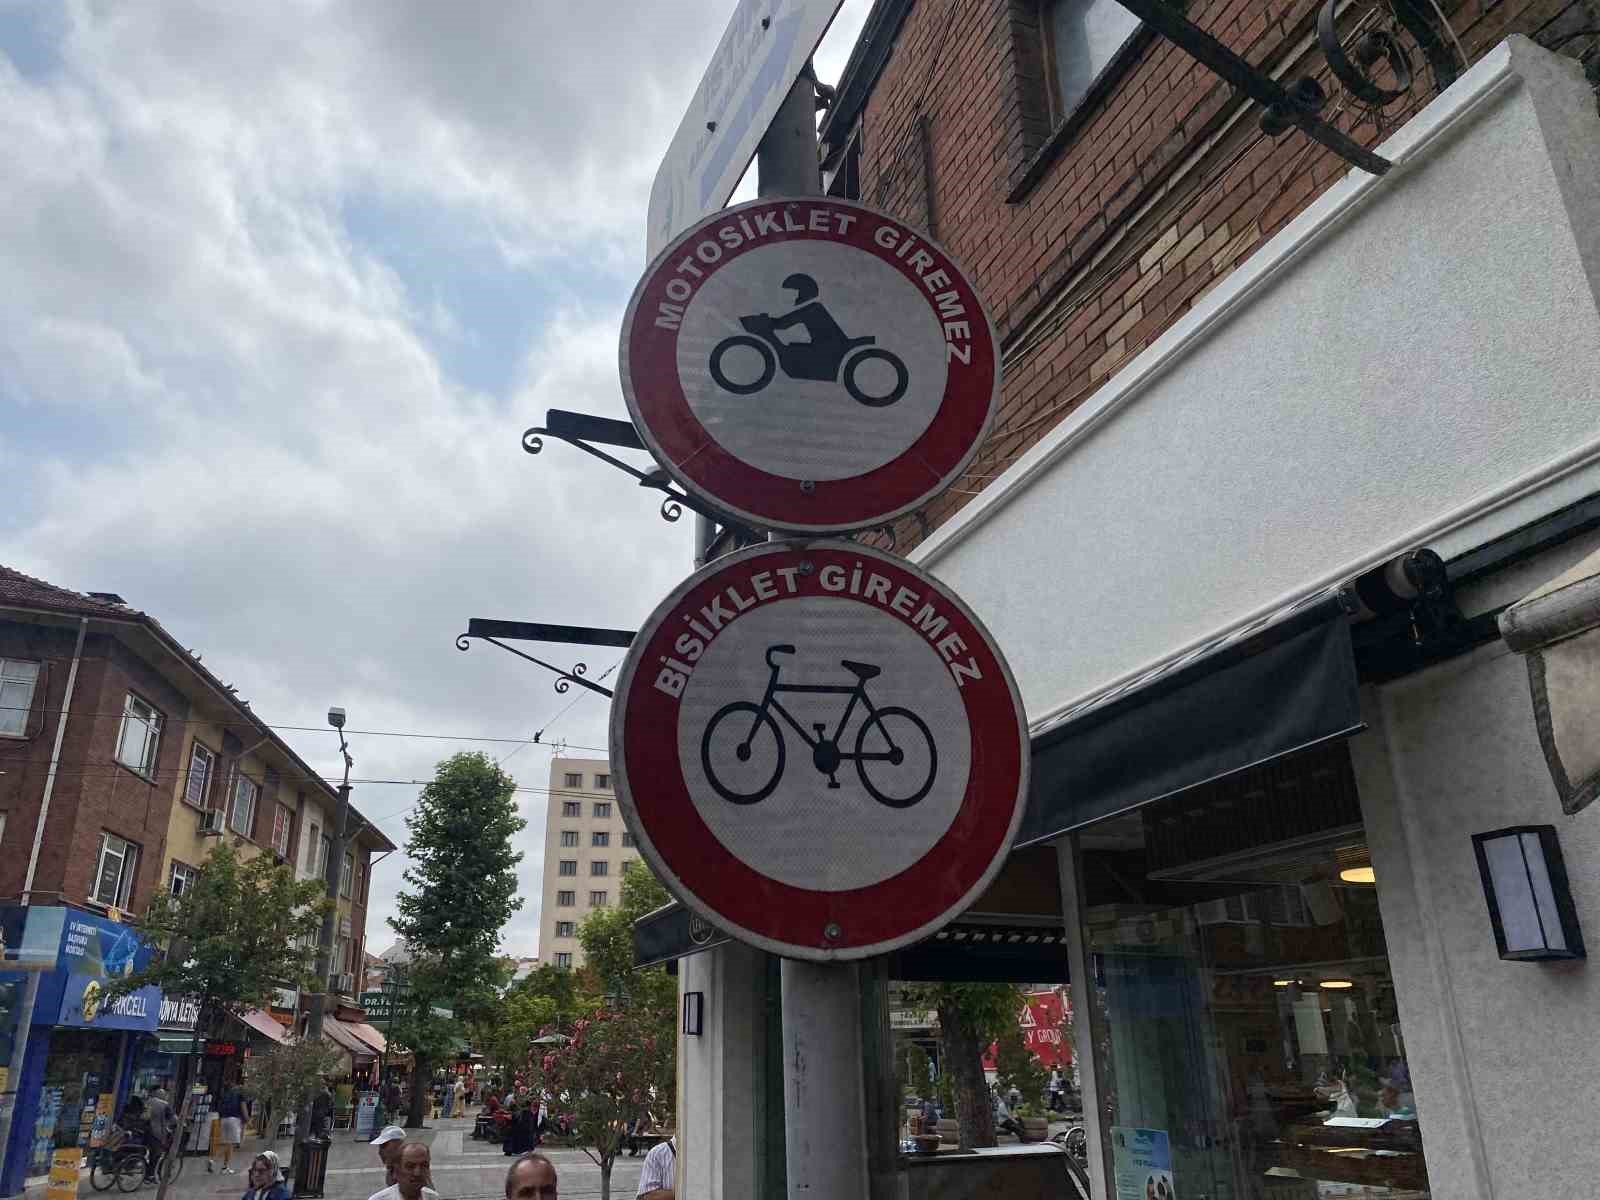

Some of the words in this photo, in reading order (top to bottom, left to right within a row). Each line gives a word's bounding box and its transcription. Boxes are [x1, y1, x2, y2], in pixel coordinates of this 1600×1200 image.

[654, 208, 857, 331] MOTOSİKLET
[873, 224, 973, 366] GİREMEZ
[652, 567, 802, 699] BİSİKLET
[819, 560, 984, 687] GİREMEZ
